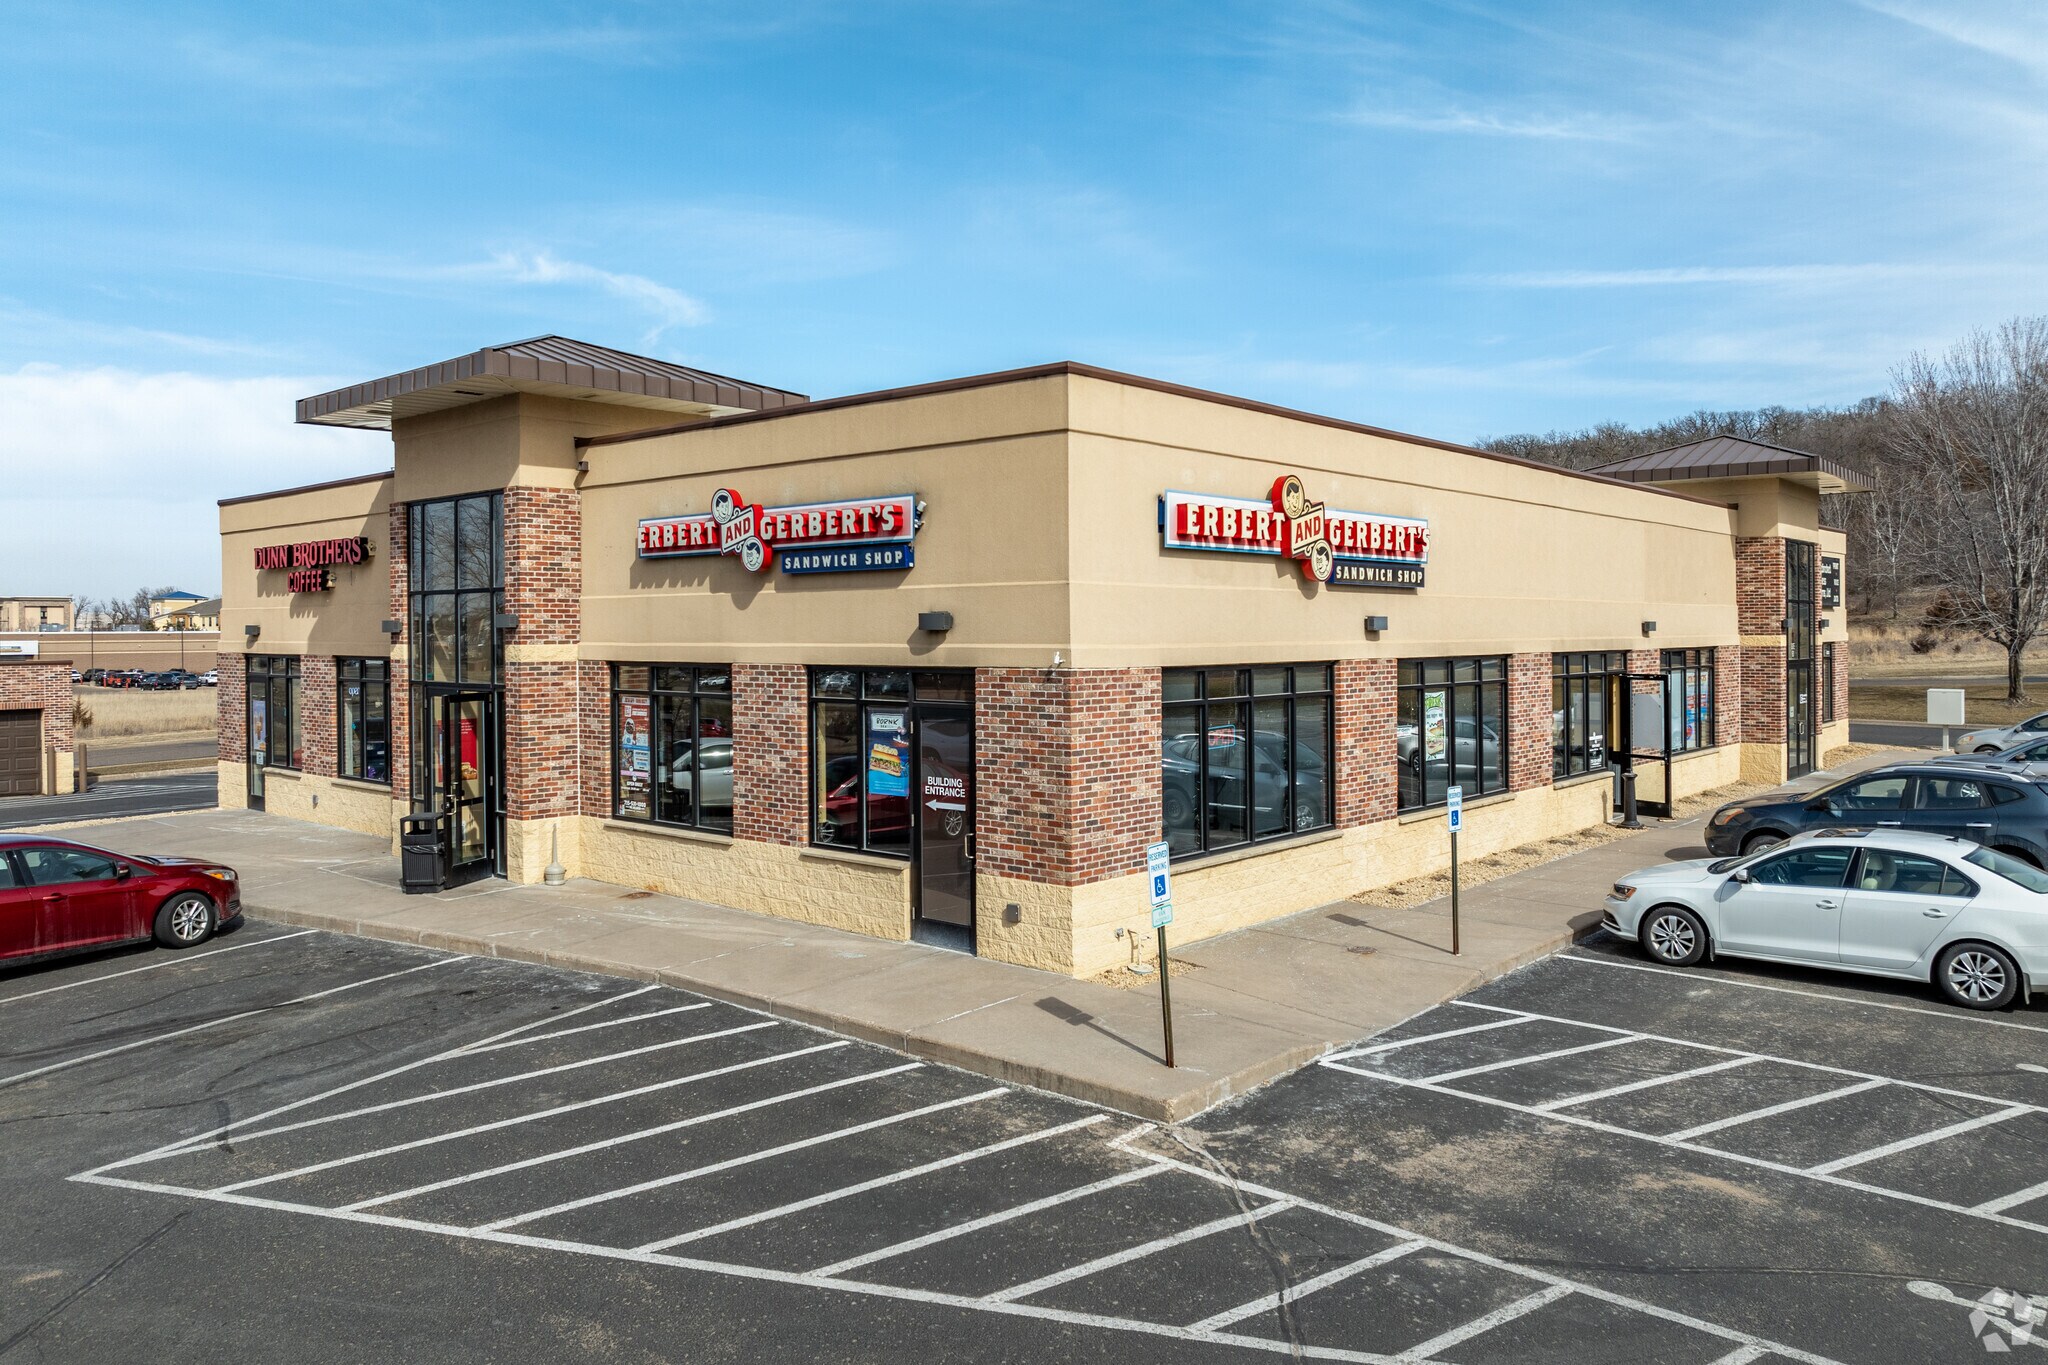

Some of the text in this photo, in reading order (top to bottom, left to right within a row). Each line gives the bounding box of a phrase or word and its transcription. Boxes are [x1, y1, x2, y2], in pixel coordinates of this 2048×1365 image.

[637, 505, 895, 548] ERBERT AND GERBERT'S
[1186, 502, 1431, 552] ERBERT AND GERBERT'S
[254, 536, 361, 569] DUNN BROTHERS
[784, 551, 903, 570] SANDWICH SHOP
[288, 570, 322, 592] COFFEE
[1336, 565, 1423, 584] SANDWICH SHOP
[1208, 728, 1235, 746] OPEN
[927, 776, 963, 787] BUILDING
[925, 786, 966, 798] ENTRANCE
[1148, 849, 1168, 862] RESERVED
[1150, 861, 1167, 872] PARKING
